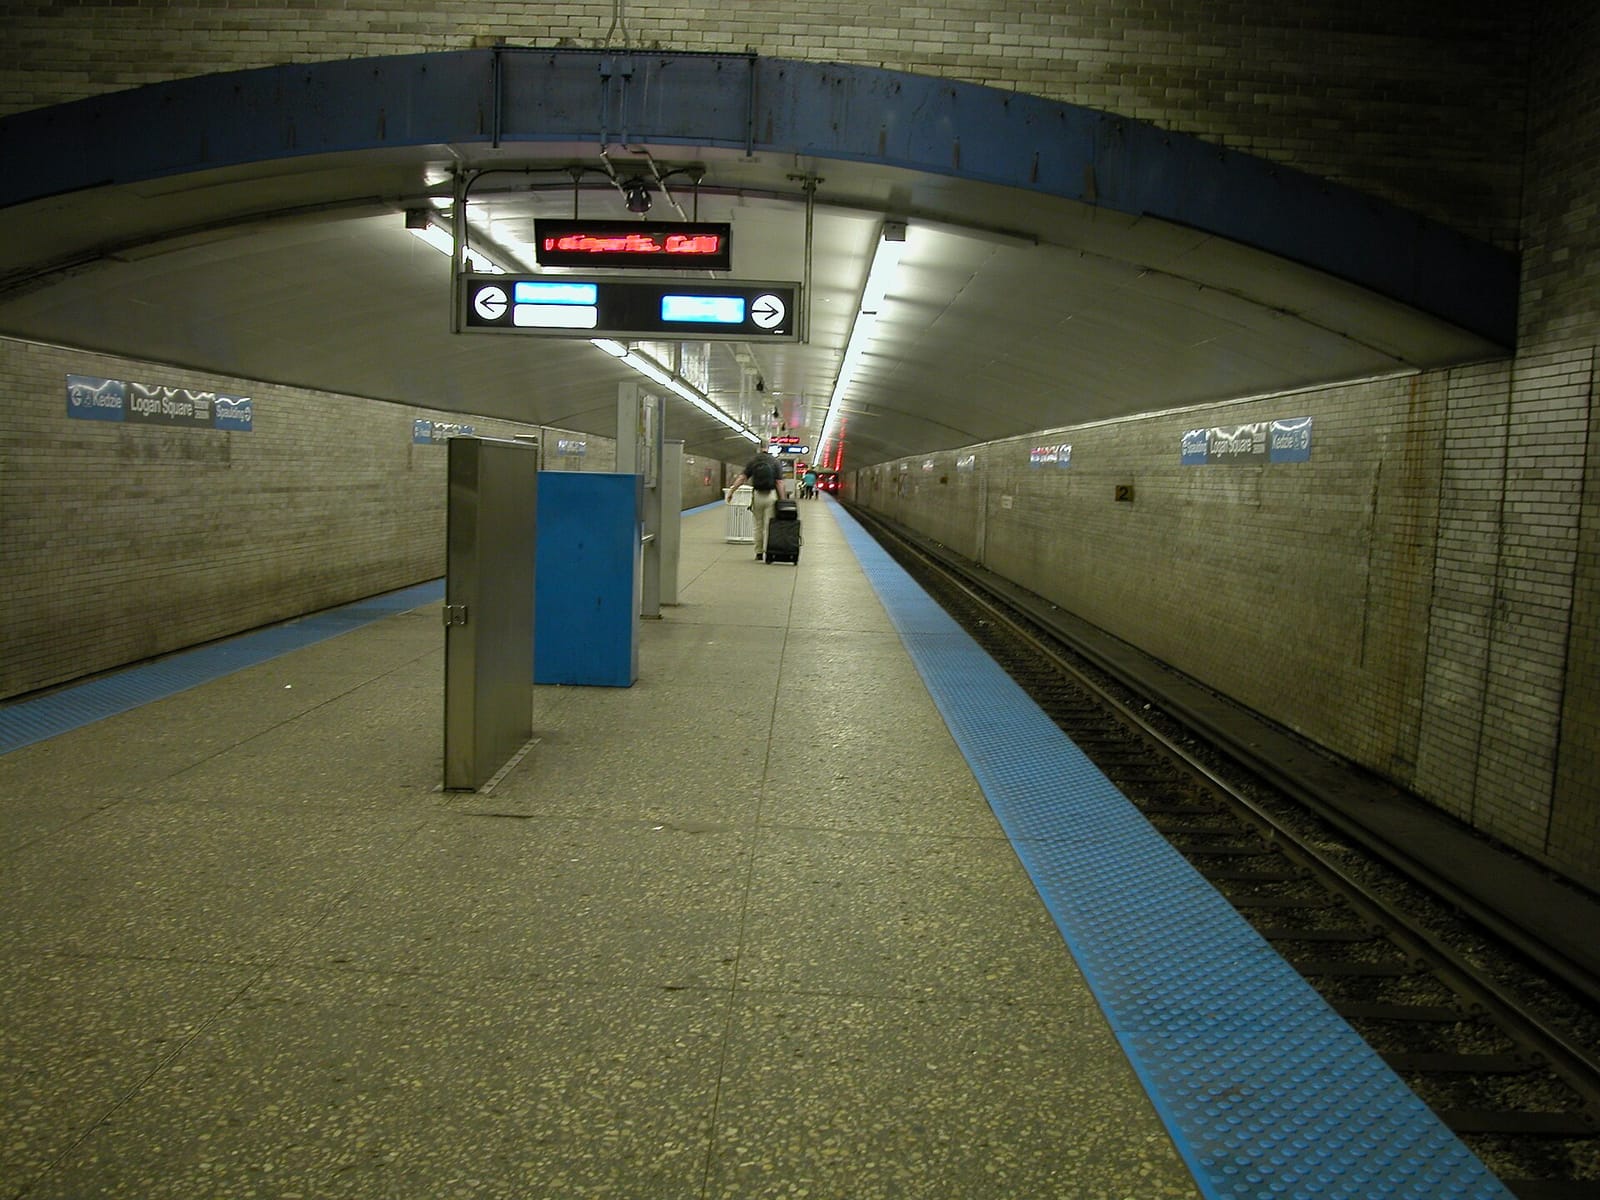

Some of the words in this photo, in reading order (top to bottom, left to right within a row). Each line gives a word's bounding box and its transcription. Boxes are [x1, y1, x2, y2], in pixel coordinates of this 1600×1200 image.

[92, 391, 122, 409] Kedzie
[130, 393, 161, 416] Logan
[162, 397, 193, 419] Square
[215, 405, 245, 422] Spaulding
[1210, 440, 1229, 458] Logan
[1120, 487, 1129, 500] 2
